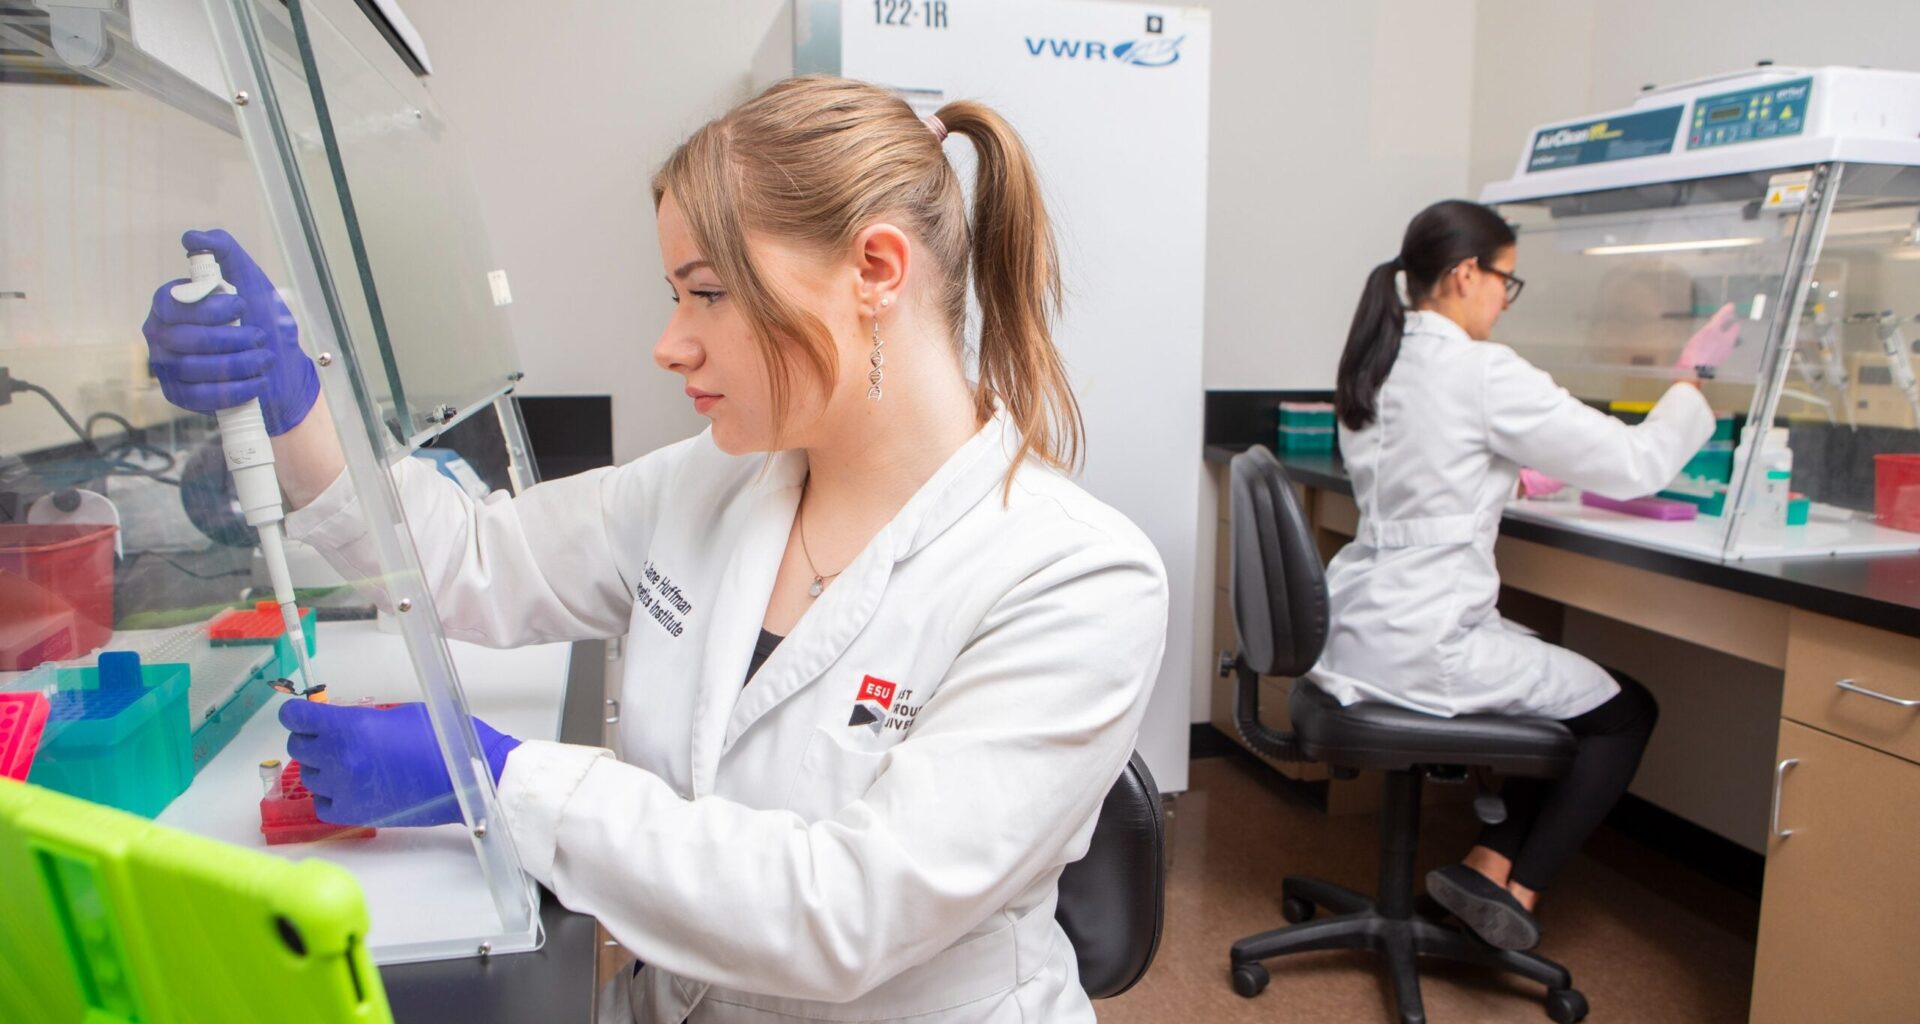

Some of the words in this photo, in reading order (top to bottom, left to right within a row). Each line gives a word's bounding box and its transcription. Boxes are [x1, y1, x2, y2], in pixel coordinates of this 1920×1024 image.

[1025, 37, 1107, 60] VWR
[656, 576, 692, 616] Huffman
[649, 600, 683, 637] Institute
[866, 683, 890, 699] ESU
